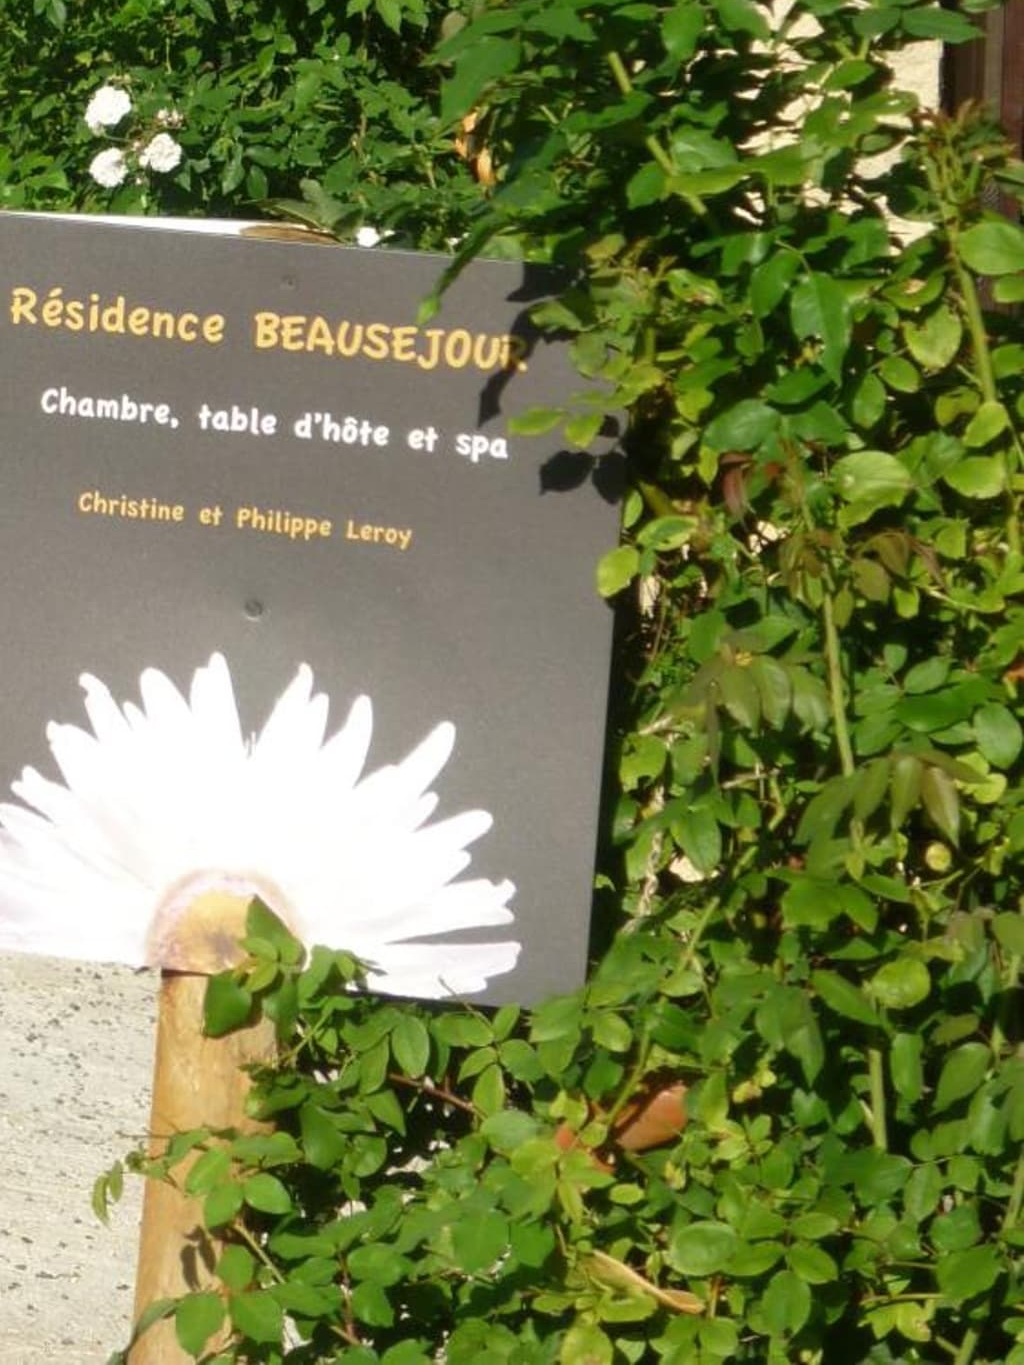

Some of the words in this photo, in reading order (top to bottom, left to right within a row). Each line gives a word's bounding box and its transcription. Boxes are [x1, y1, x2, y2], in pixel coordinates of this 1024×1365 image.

[11, 287, 225, 342] Résidence
[41, 386, 179, 428] Chambre,
[199, 404, 277, 435] table
[294, 412, 389, 446] d'hôte
[408, 427, 438, 451] et
[456, 434, 508, 462] spa
[78, 490, 184, 521] Christine
[199, 506, 223, 526] et
[237, 507, 332, 540] Philippe
[346, 520, 412, 550] Leroy
